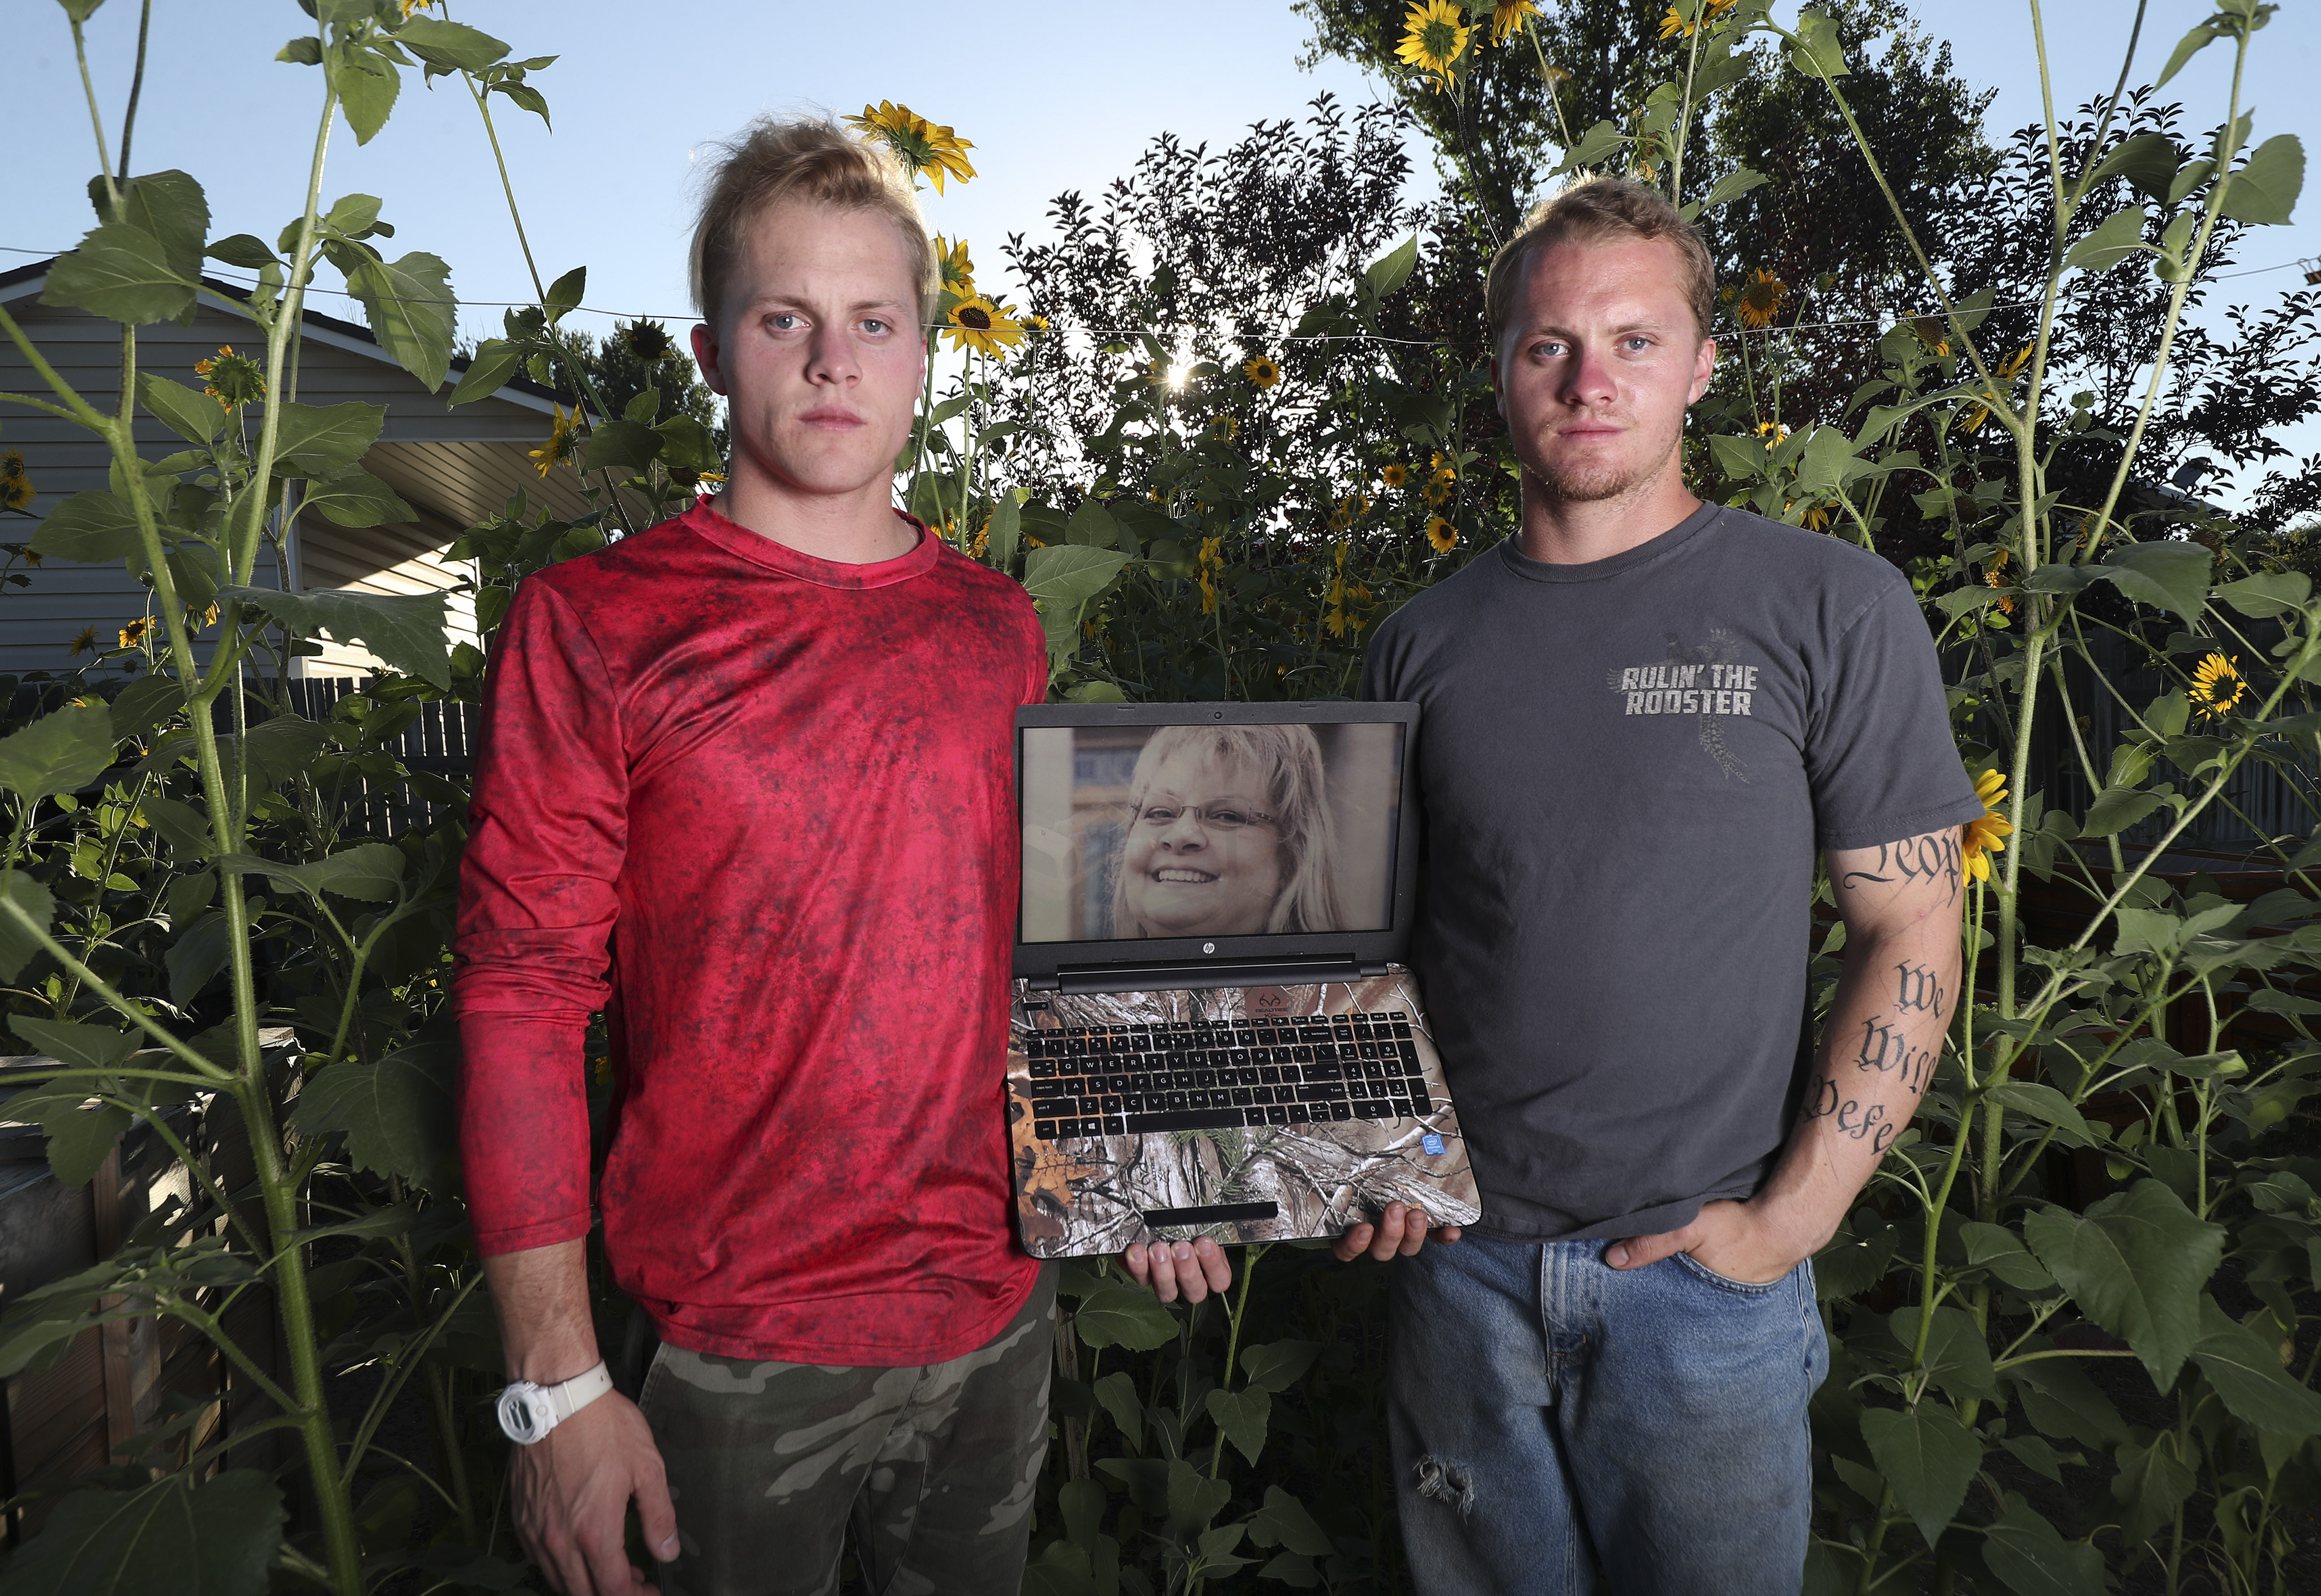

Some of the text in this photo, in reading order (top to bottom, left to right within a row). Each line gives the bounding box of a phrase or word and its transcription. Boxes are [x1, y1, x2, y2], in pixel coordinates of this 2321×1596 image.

[1621, 664, 1759, 690] RULIN' THE
[1625, 690, 1752, 716] ROOSTER
[1204, 943, 1215, 955] hp
[1894, 959, 1945, 1019] We
[1853, 1016, 1937, 1097] Will
